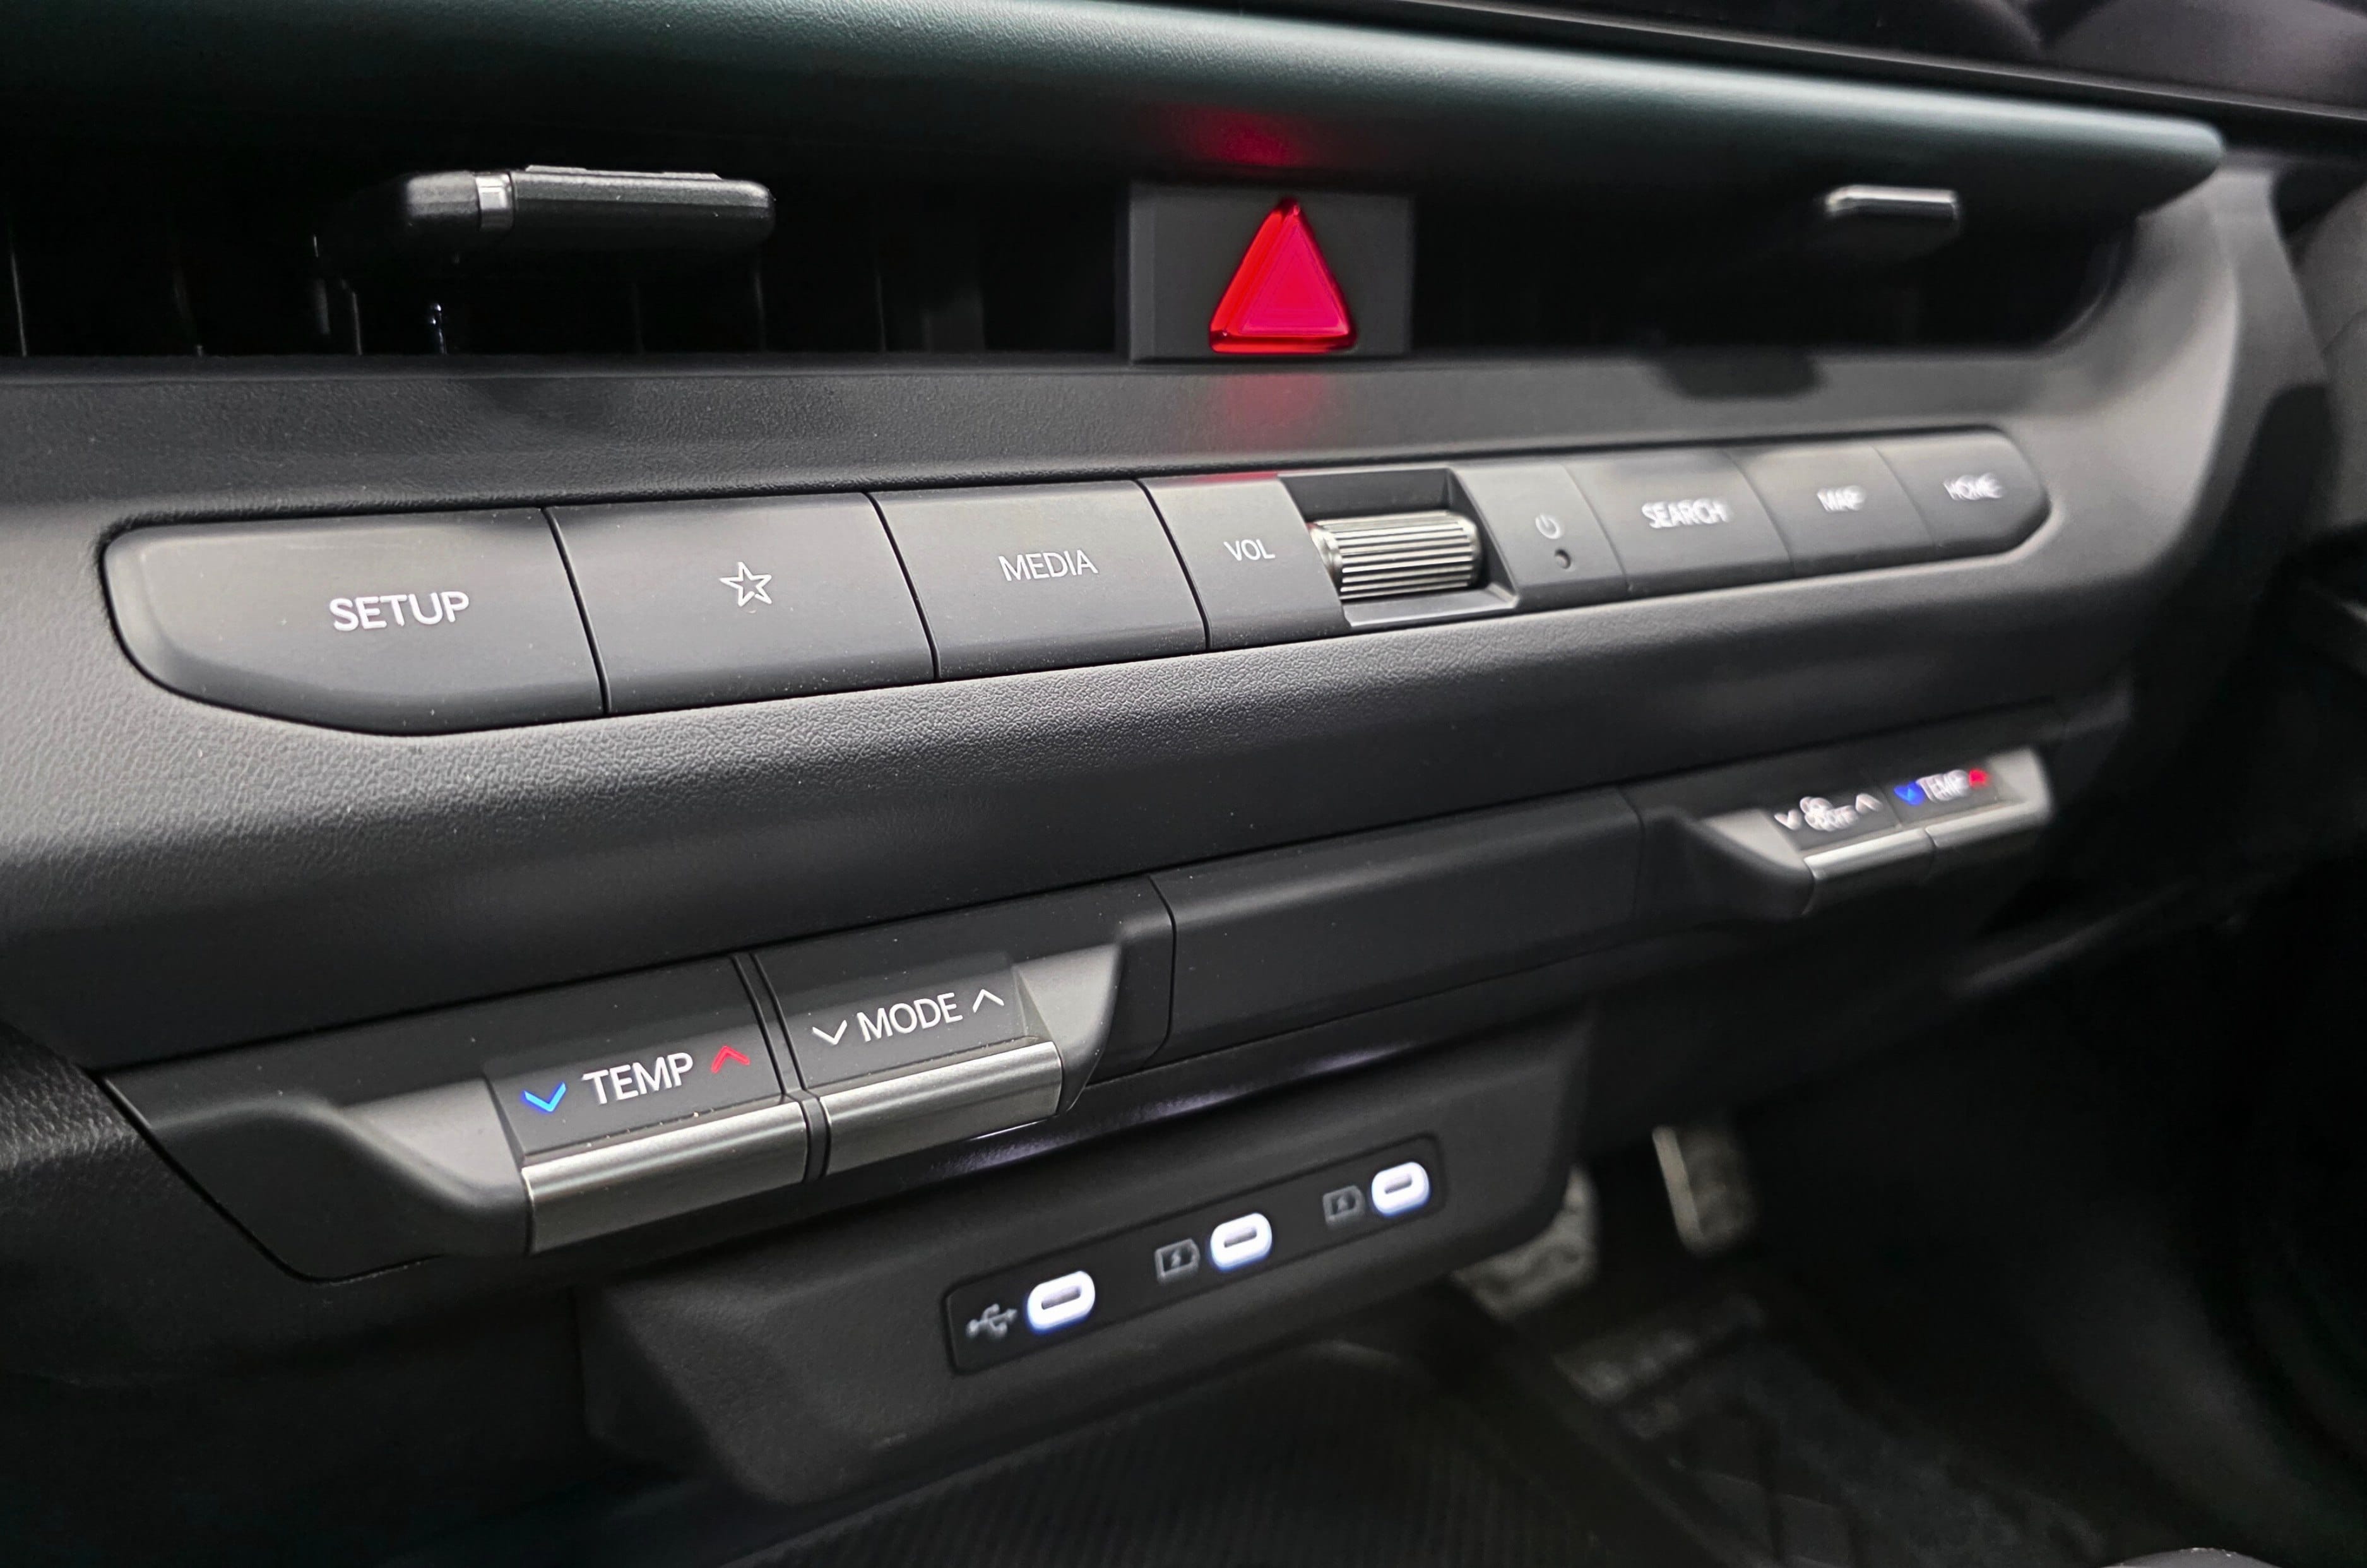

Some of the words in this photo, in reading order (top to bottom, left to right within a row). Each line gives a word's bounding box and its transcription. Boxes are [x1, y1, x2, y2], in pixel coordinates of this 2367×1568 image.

[1642, 499, 1730, 529] SEARCH
[999, 550, 1099, 581] MEDIA
[1223, 539, 1276, 561] VOL
[329, 591, 470, 632] SETUP
[1916, 769, 1969, 802] TEMP
[857, 991, 963, 1042] MODE
[581, 1052, 694, 1106] TEMP
